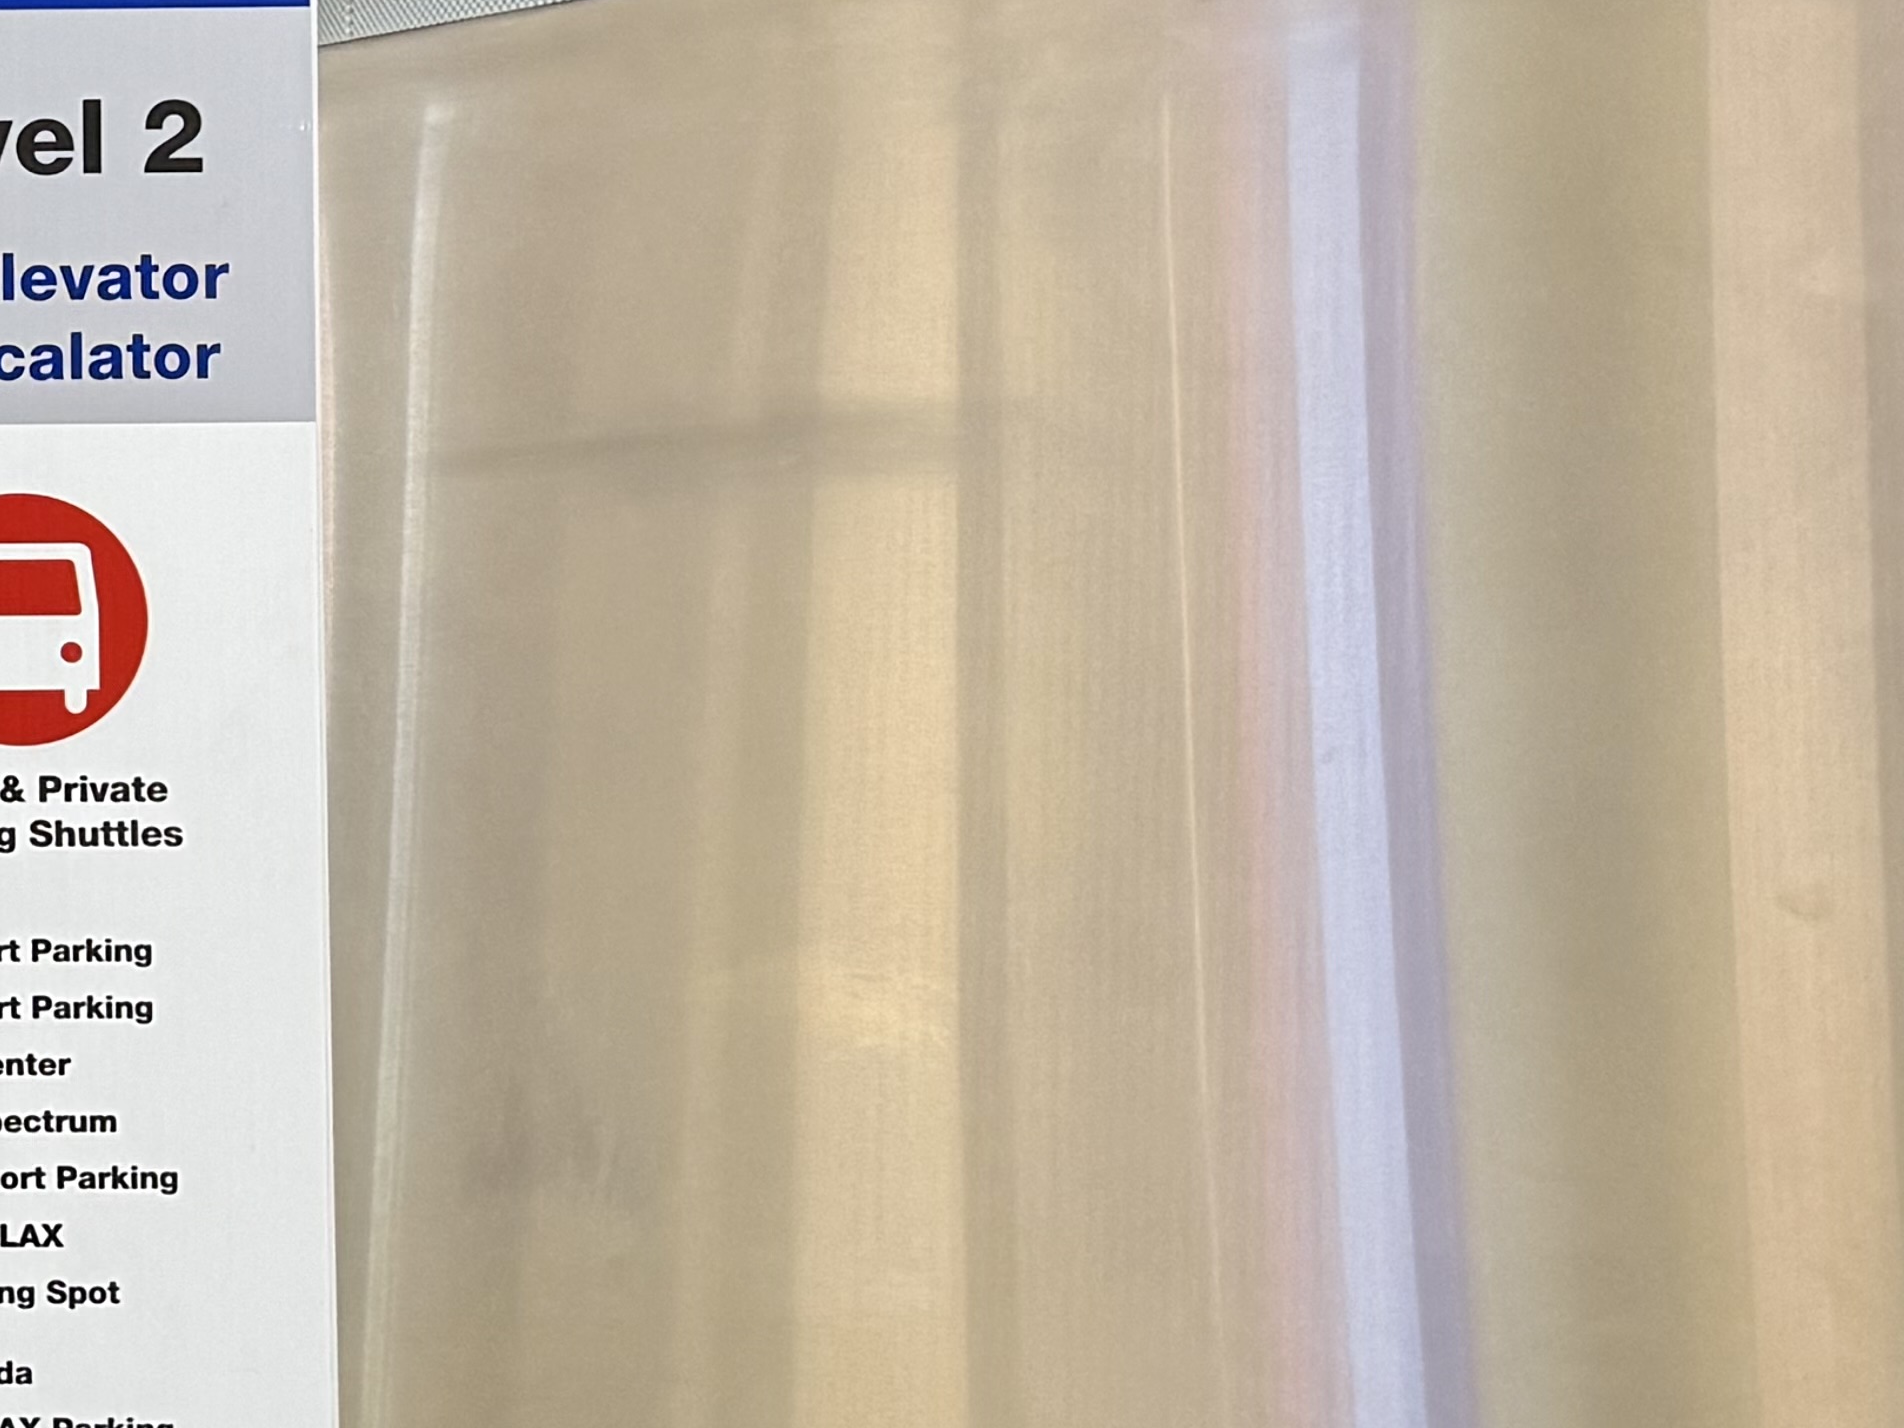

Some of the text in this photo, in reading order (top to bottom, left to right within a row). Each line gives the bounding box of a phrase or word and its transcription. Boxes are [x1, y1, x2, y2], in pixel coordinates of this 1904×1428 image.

[144, 100, 205, 175] 2
[0, 775, 27, 804] &
[39, 775, 169, 804] Private
[30, 820, 185, 849] Shuttles
[32, 939, 153, 969] Parking
[33, 995, 154, 1026] Parking
[57, 1166, 179, 1197] Parking
[0, 1224, 65, 1249] LAX
[47, 1280, 122, 1311] Spot
